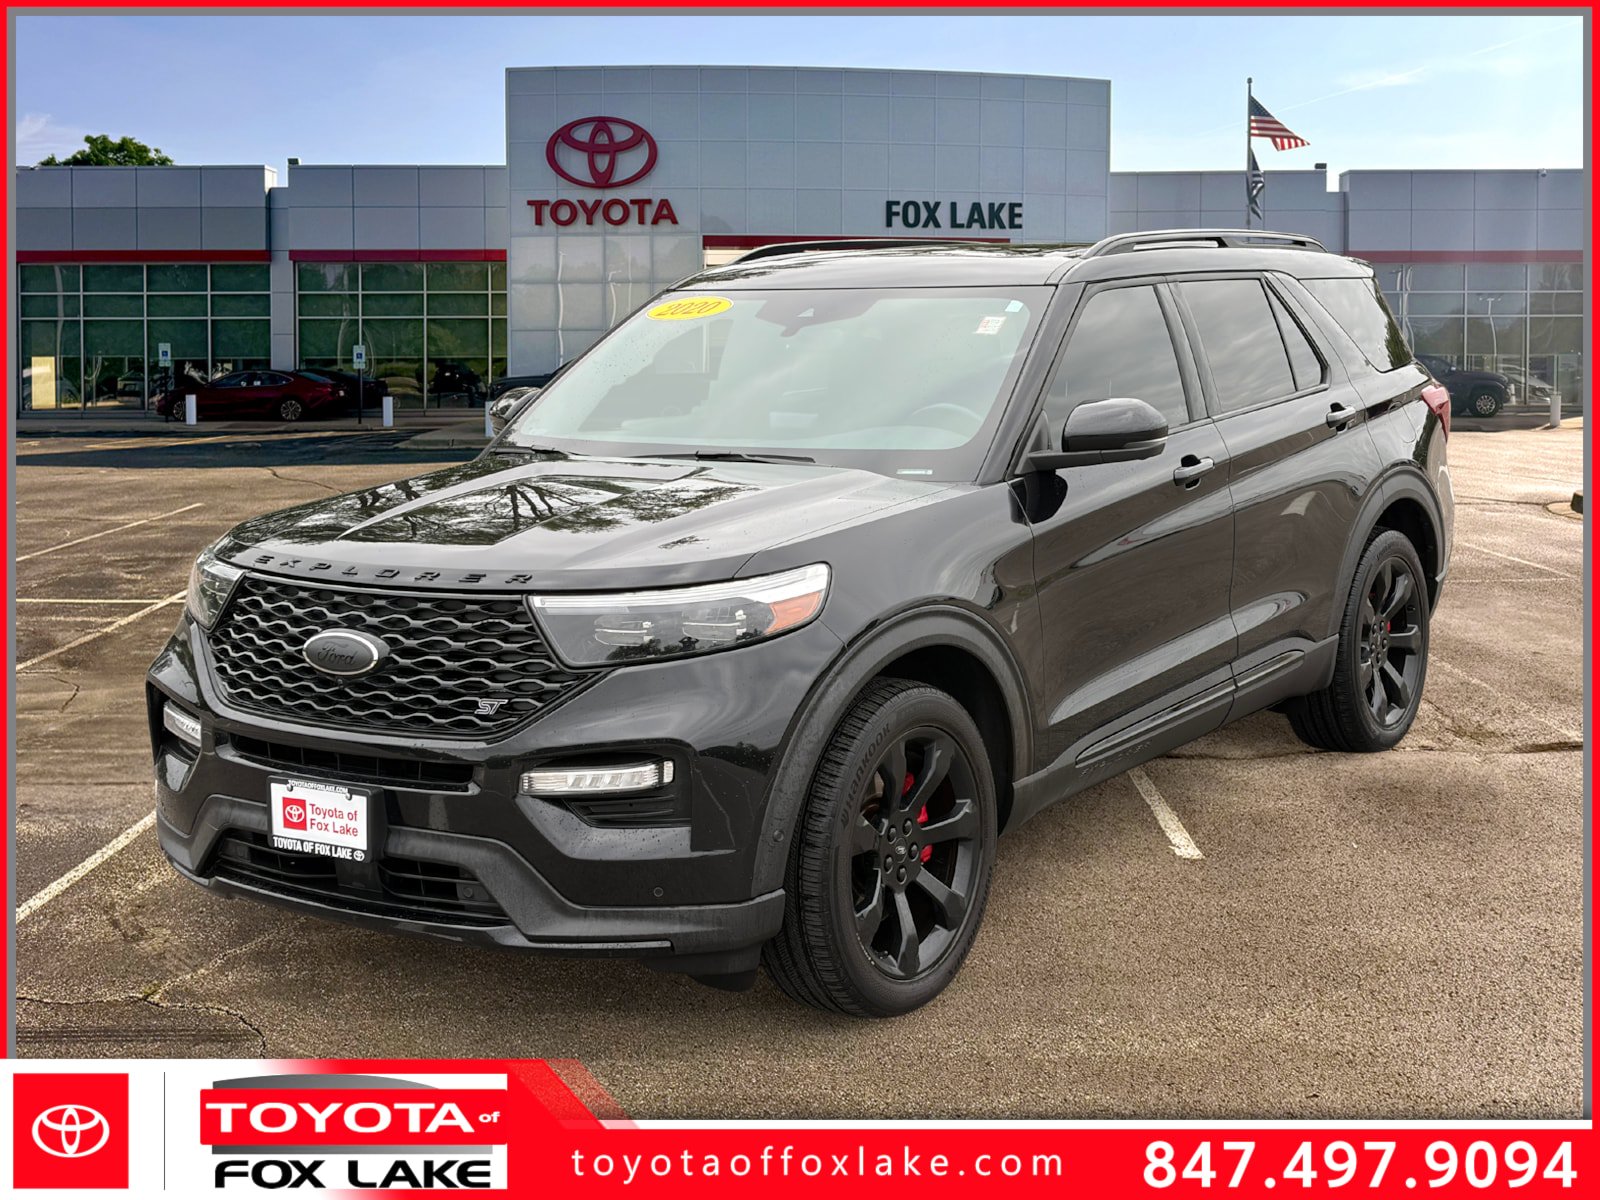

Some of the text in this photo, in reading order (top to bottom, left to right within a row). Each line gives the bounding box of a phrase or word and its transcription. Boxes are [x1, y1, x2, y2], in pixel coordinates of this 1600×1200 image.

[527, 199, 679, 226] TOYOTA
[885, 200, 1023, 229] FOX LAKE
[654, 301, 721, 317] 2020
[252, 555, 533, 584] EXPLORER
[317, 641, 358, 665] Ford
[474, 698, 509, 715] ST
[309, 803, 358, 821] Toyota of
[309, 818, 359, 837] Fox Lake
[273, 836, 353, 860] TOYOTA OF FOX LAKE
